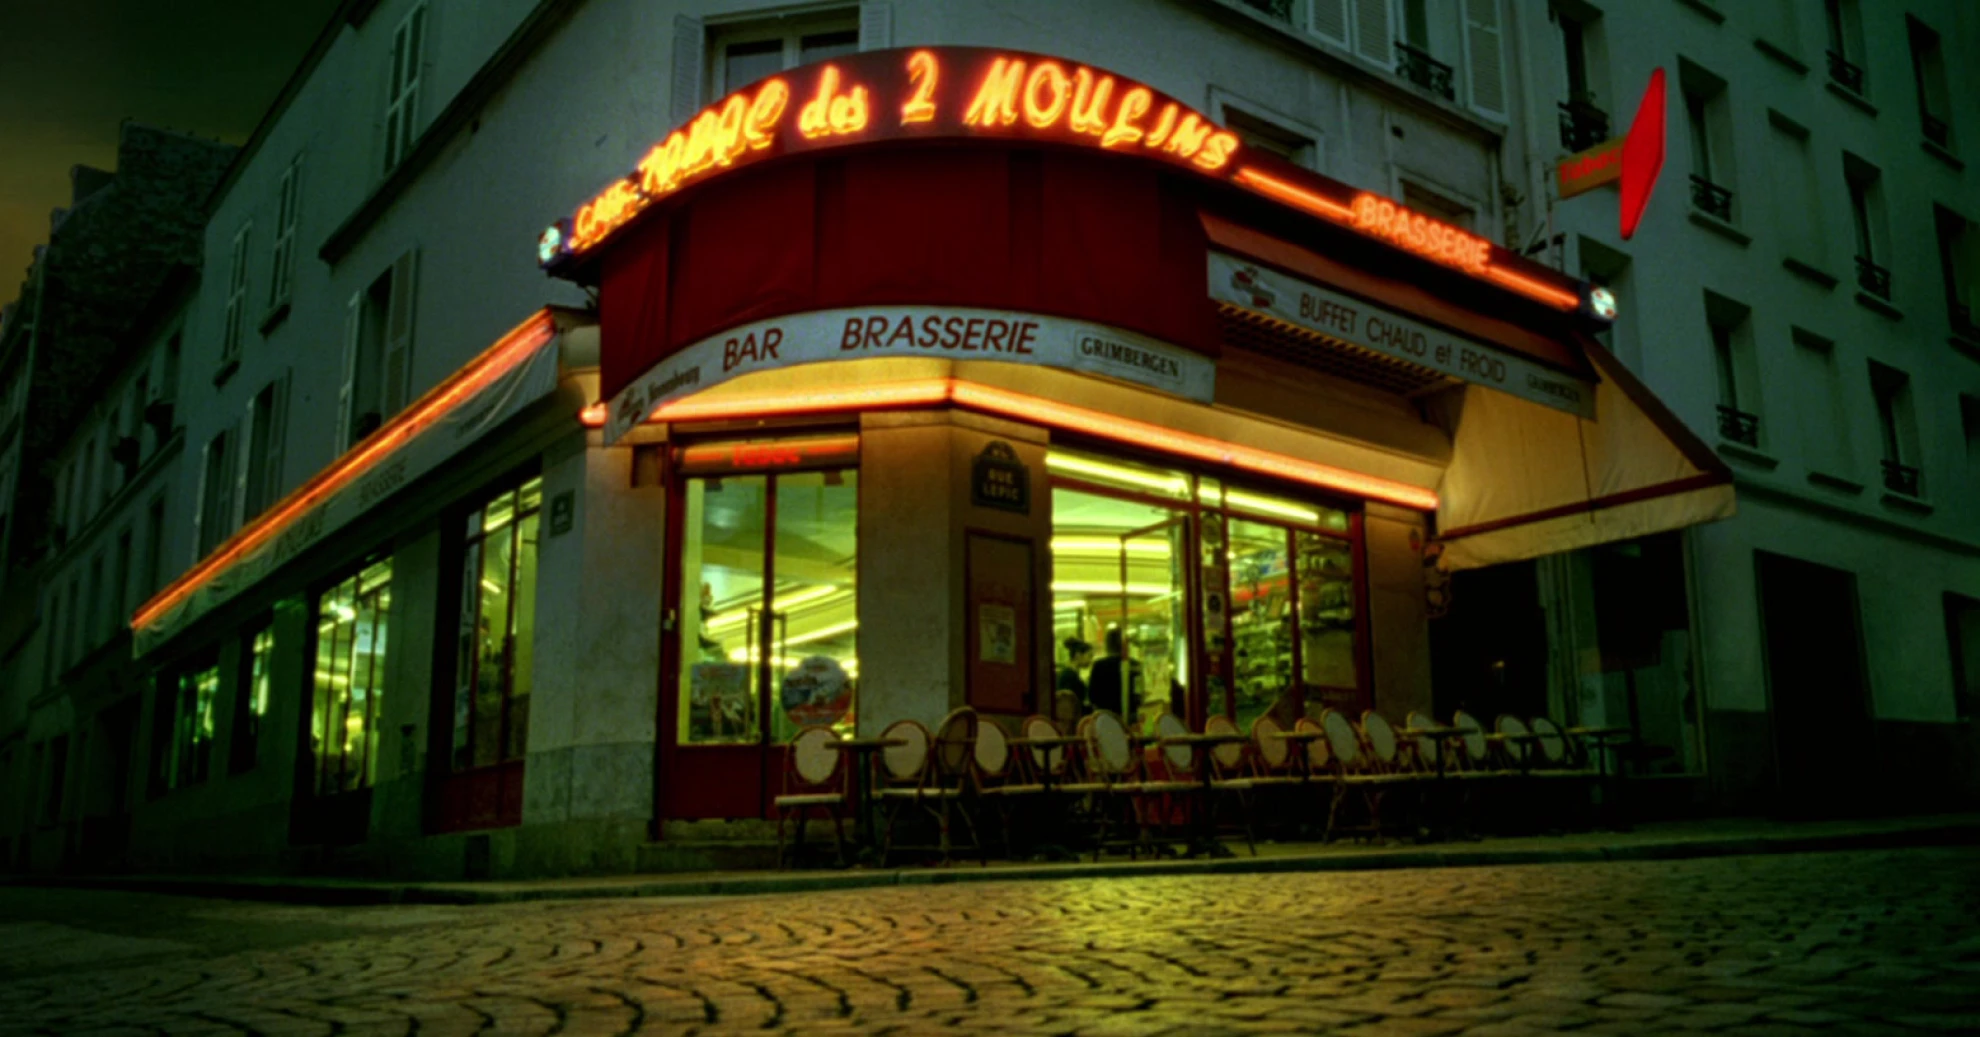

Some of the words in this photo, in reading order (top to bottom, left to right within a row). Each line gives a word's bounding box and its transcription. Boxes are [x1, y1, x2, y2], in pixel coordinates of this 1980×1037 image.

[800, 65, 867, 138] des
[900, 51, 939, 122] 2
[964, 57, 1239, 170] MOULINS
[1353, 192, 1490, 274] BRASSERIE
[722, 328, 783, 373] BAR
[840, 315, 1039, 355] BRASSERIE
[1082, 336, 1179, 379] GRIMBERGEN
[1300, 293, 1356, 334] BUFFET
[1366, 317, 1427, 358] CHAUD
[1435, 345, 1452, 366] et
[1460, 348, 1506, 384] FROID
[987, 467, 1014, 486] RUE
